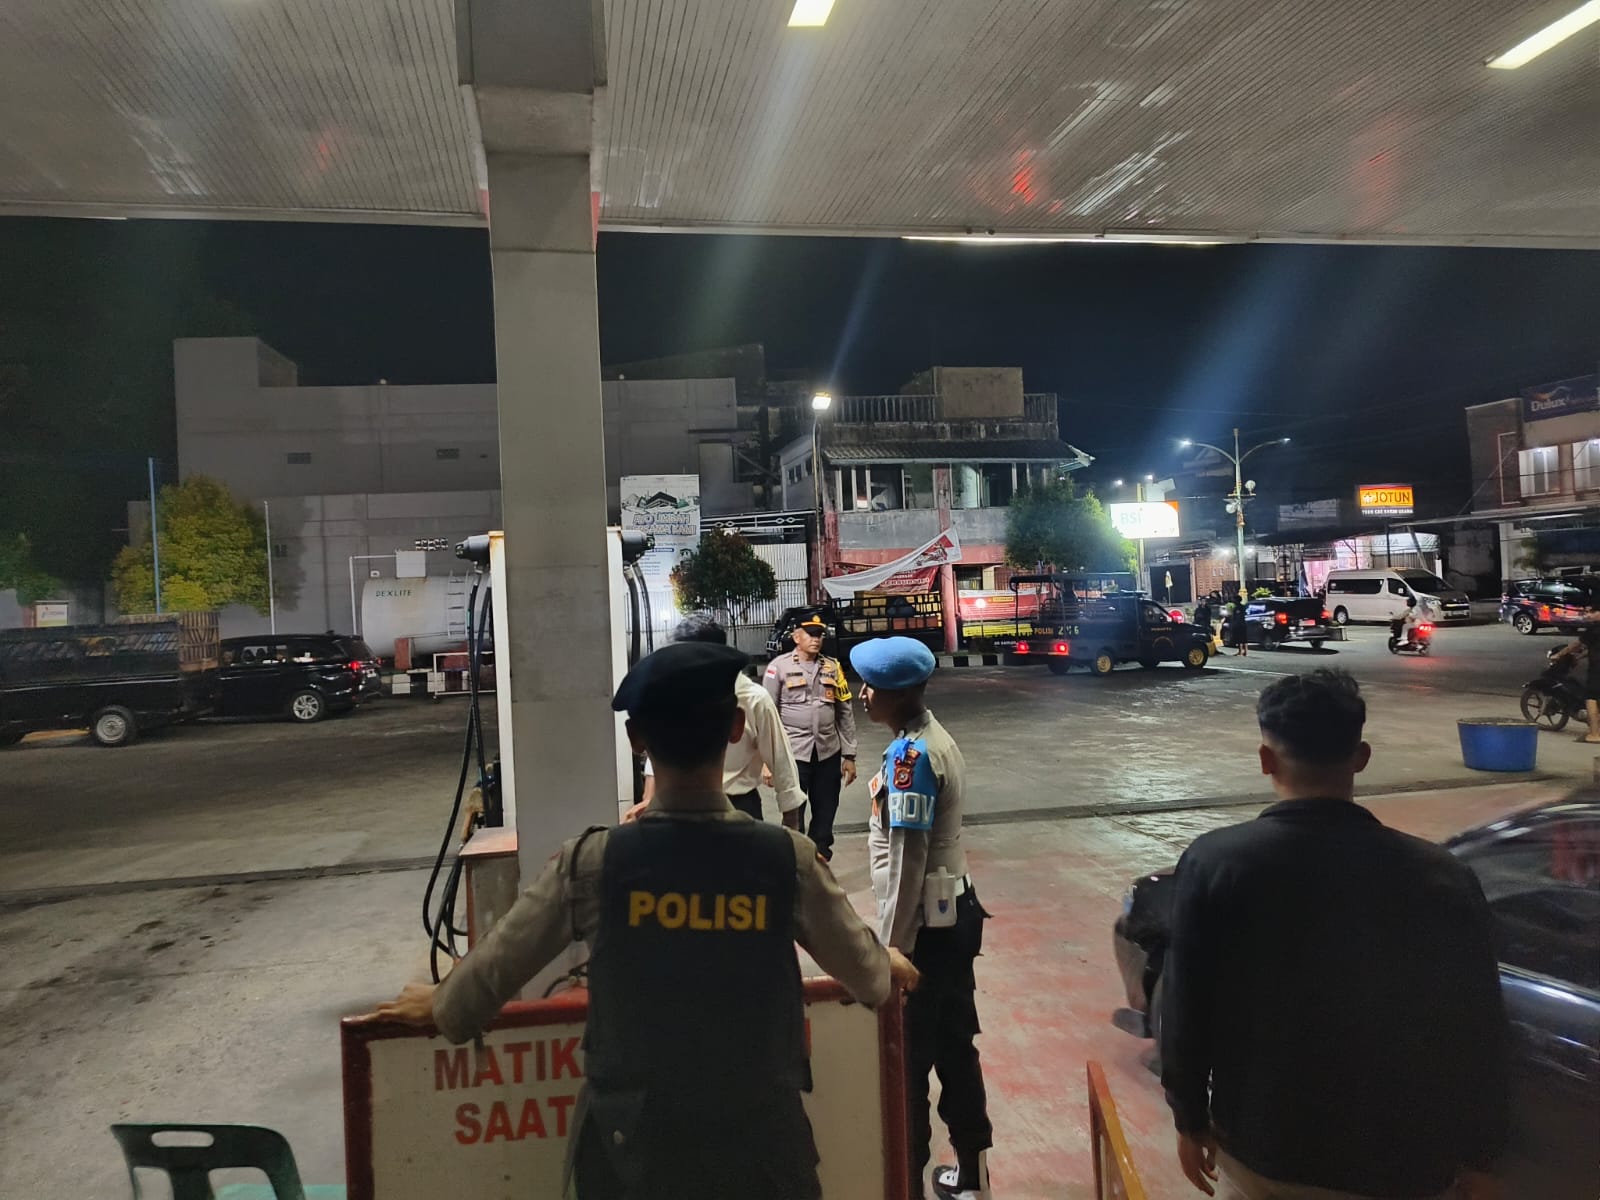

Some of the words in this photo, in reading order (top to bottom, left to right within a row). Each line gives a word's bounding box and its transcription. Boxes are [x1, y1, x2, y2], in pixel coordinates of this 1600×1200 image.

[1531, 398, 1566, 411] Dulux
[1375, 491, 1410, 503] JOTUN
[629, 891, 766, 930] POLISI
[435, 1037, 586, 1090] MATIK
[455, 1096, 576, 1145] SAAT
